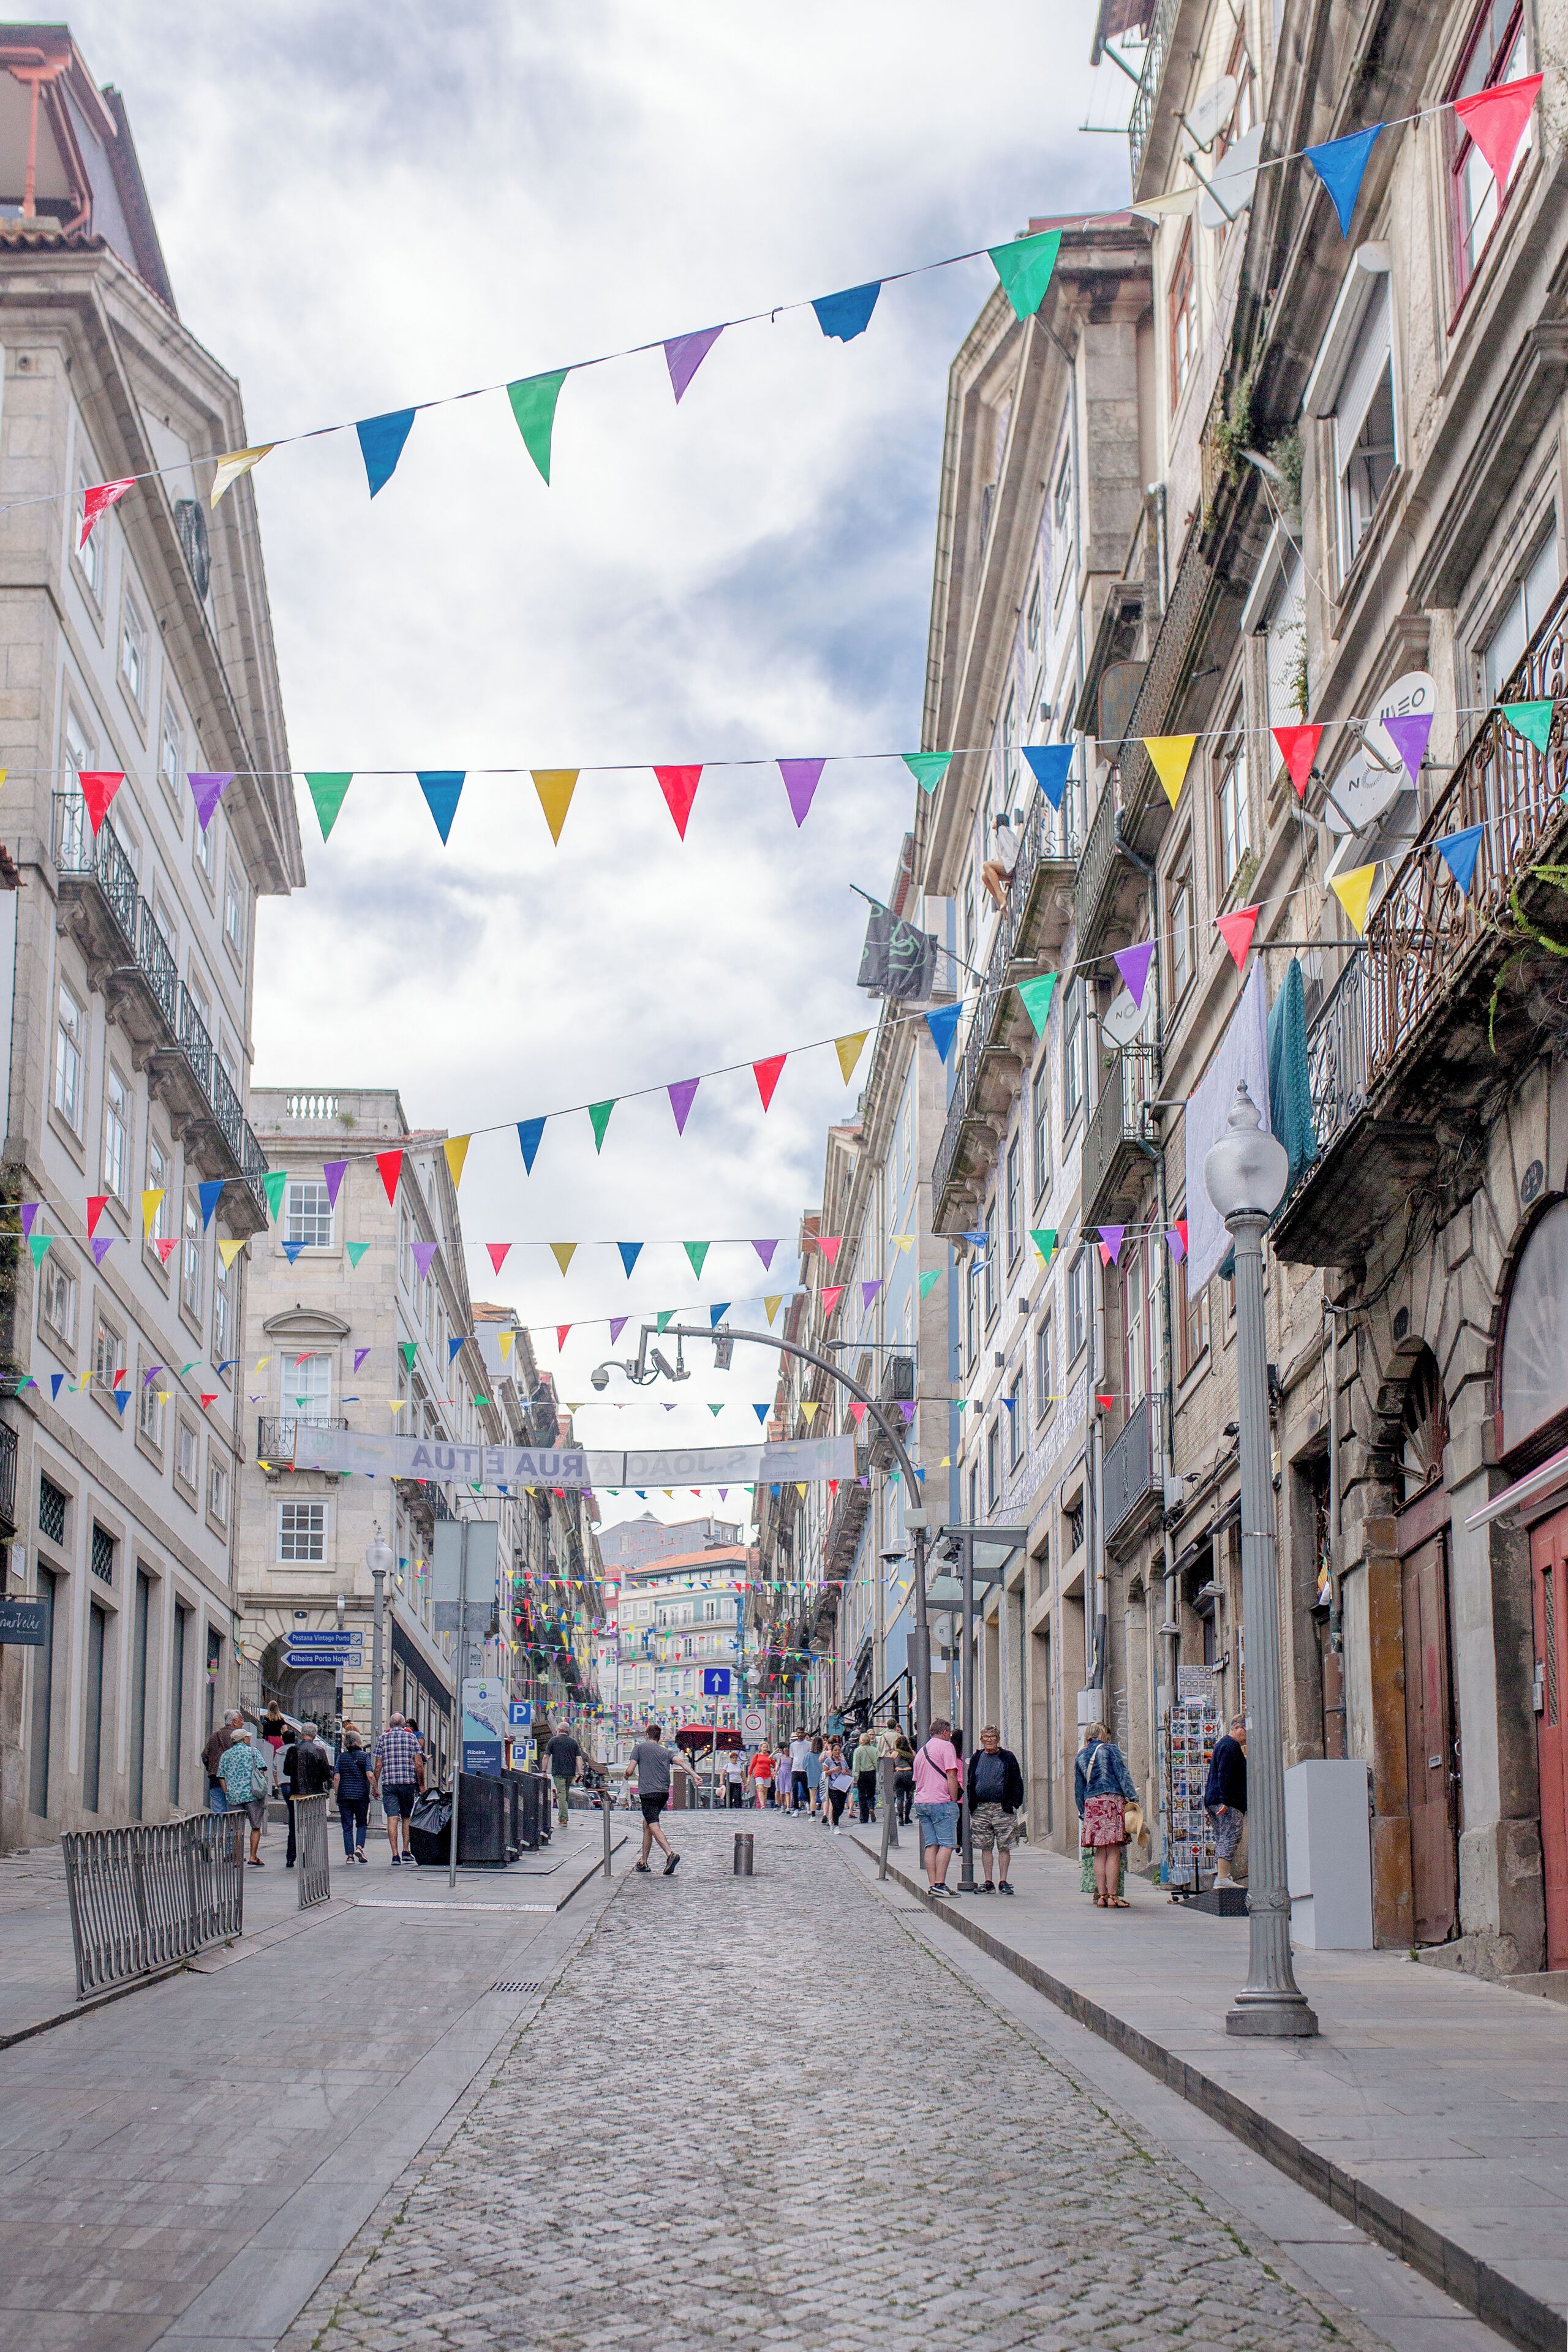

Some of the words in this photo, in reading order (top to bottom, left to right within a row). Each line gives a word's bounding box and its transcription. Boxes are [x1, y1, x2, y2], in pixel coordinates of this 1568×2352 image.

[314, 1634, 334, 1643] Vintage
[513, 1705, 526, 1722] P
[515, 1746, 524, 1758] P
